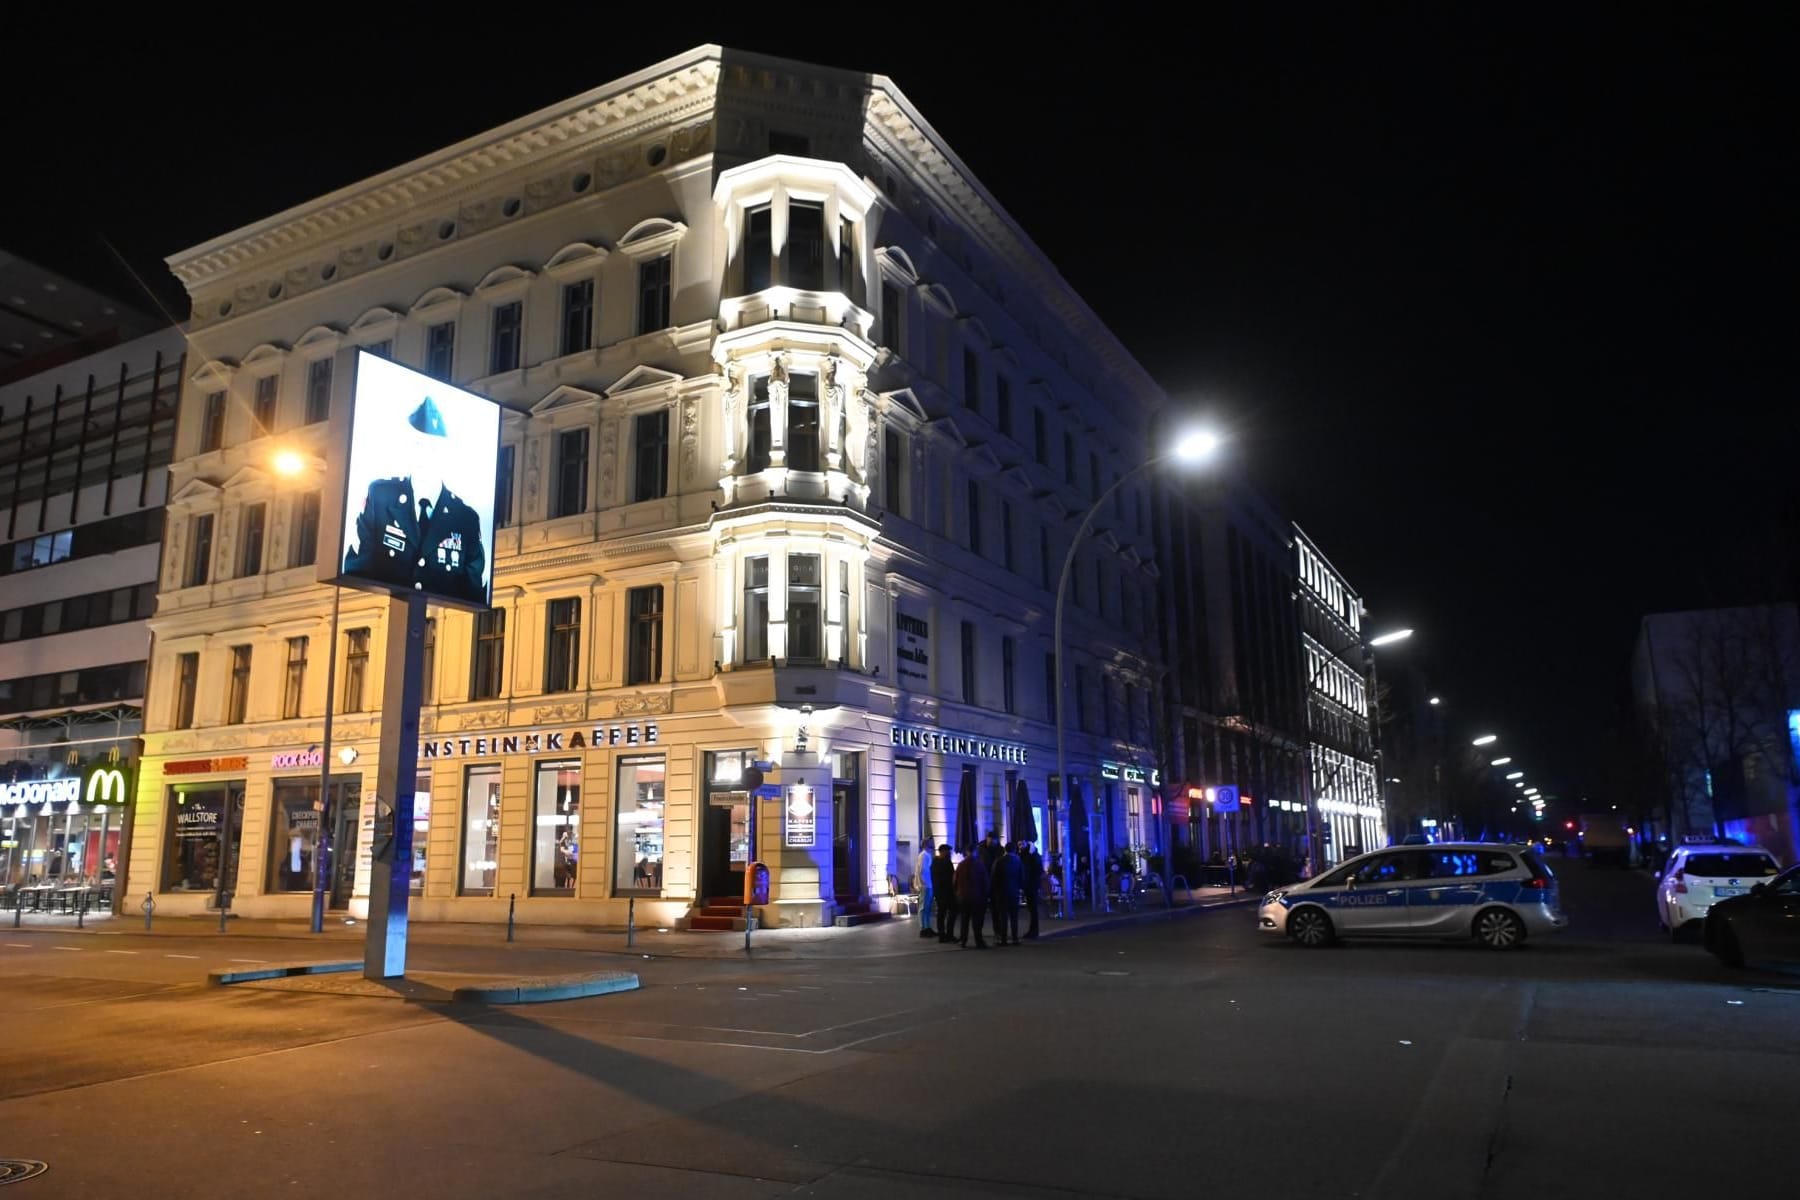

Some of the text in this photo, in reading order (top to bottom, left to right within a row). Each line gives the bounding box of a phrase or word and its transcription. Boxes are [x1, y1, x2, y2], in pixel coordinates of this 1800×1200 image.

[423, 724, 658, 758] NSTEIN KAFFEE
[891, 727, 1028, 765] EINSTEIN KAFFEE
[272, 752, 324, 769] ROCK SHO
[177, 811, 218, 824] WALLSTORE
[1340, 894, 1387, 905] POLIZEI
